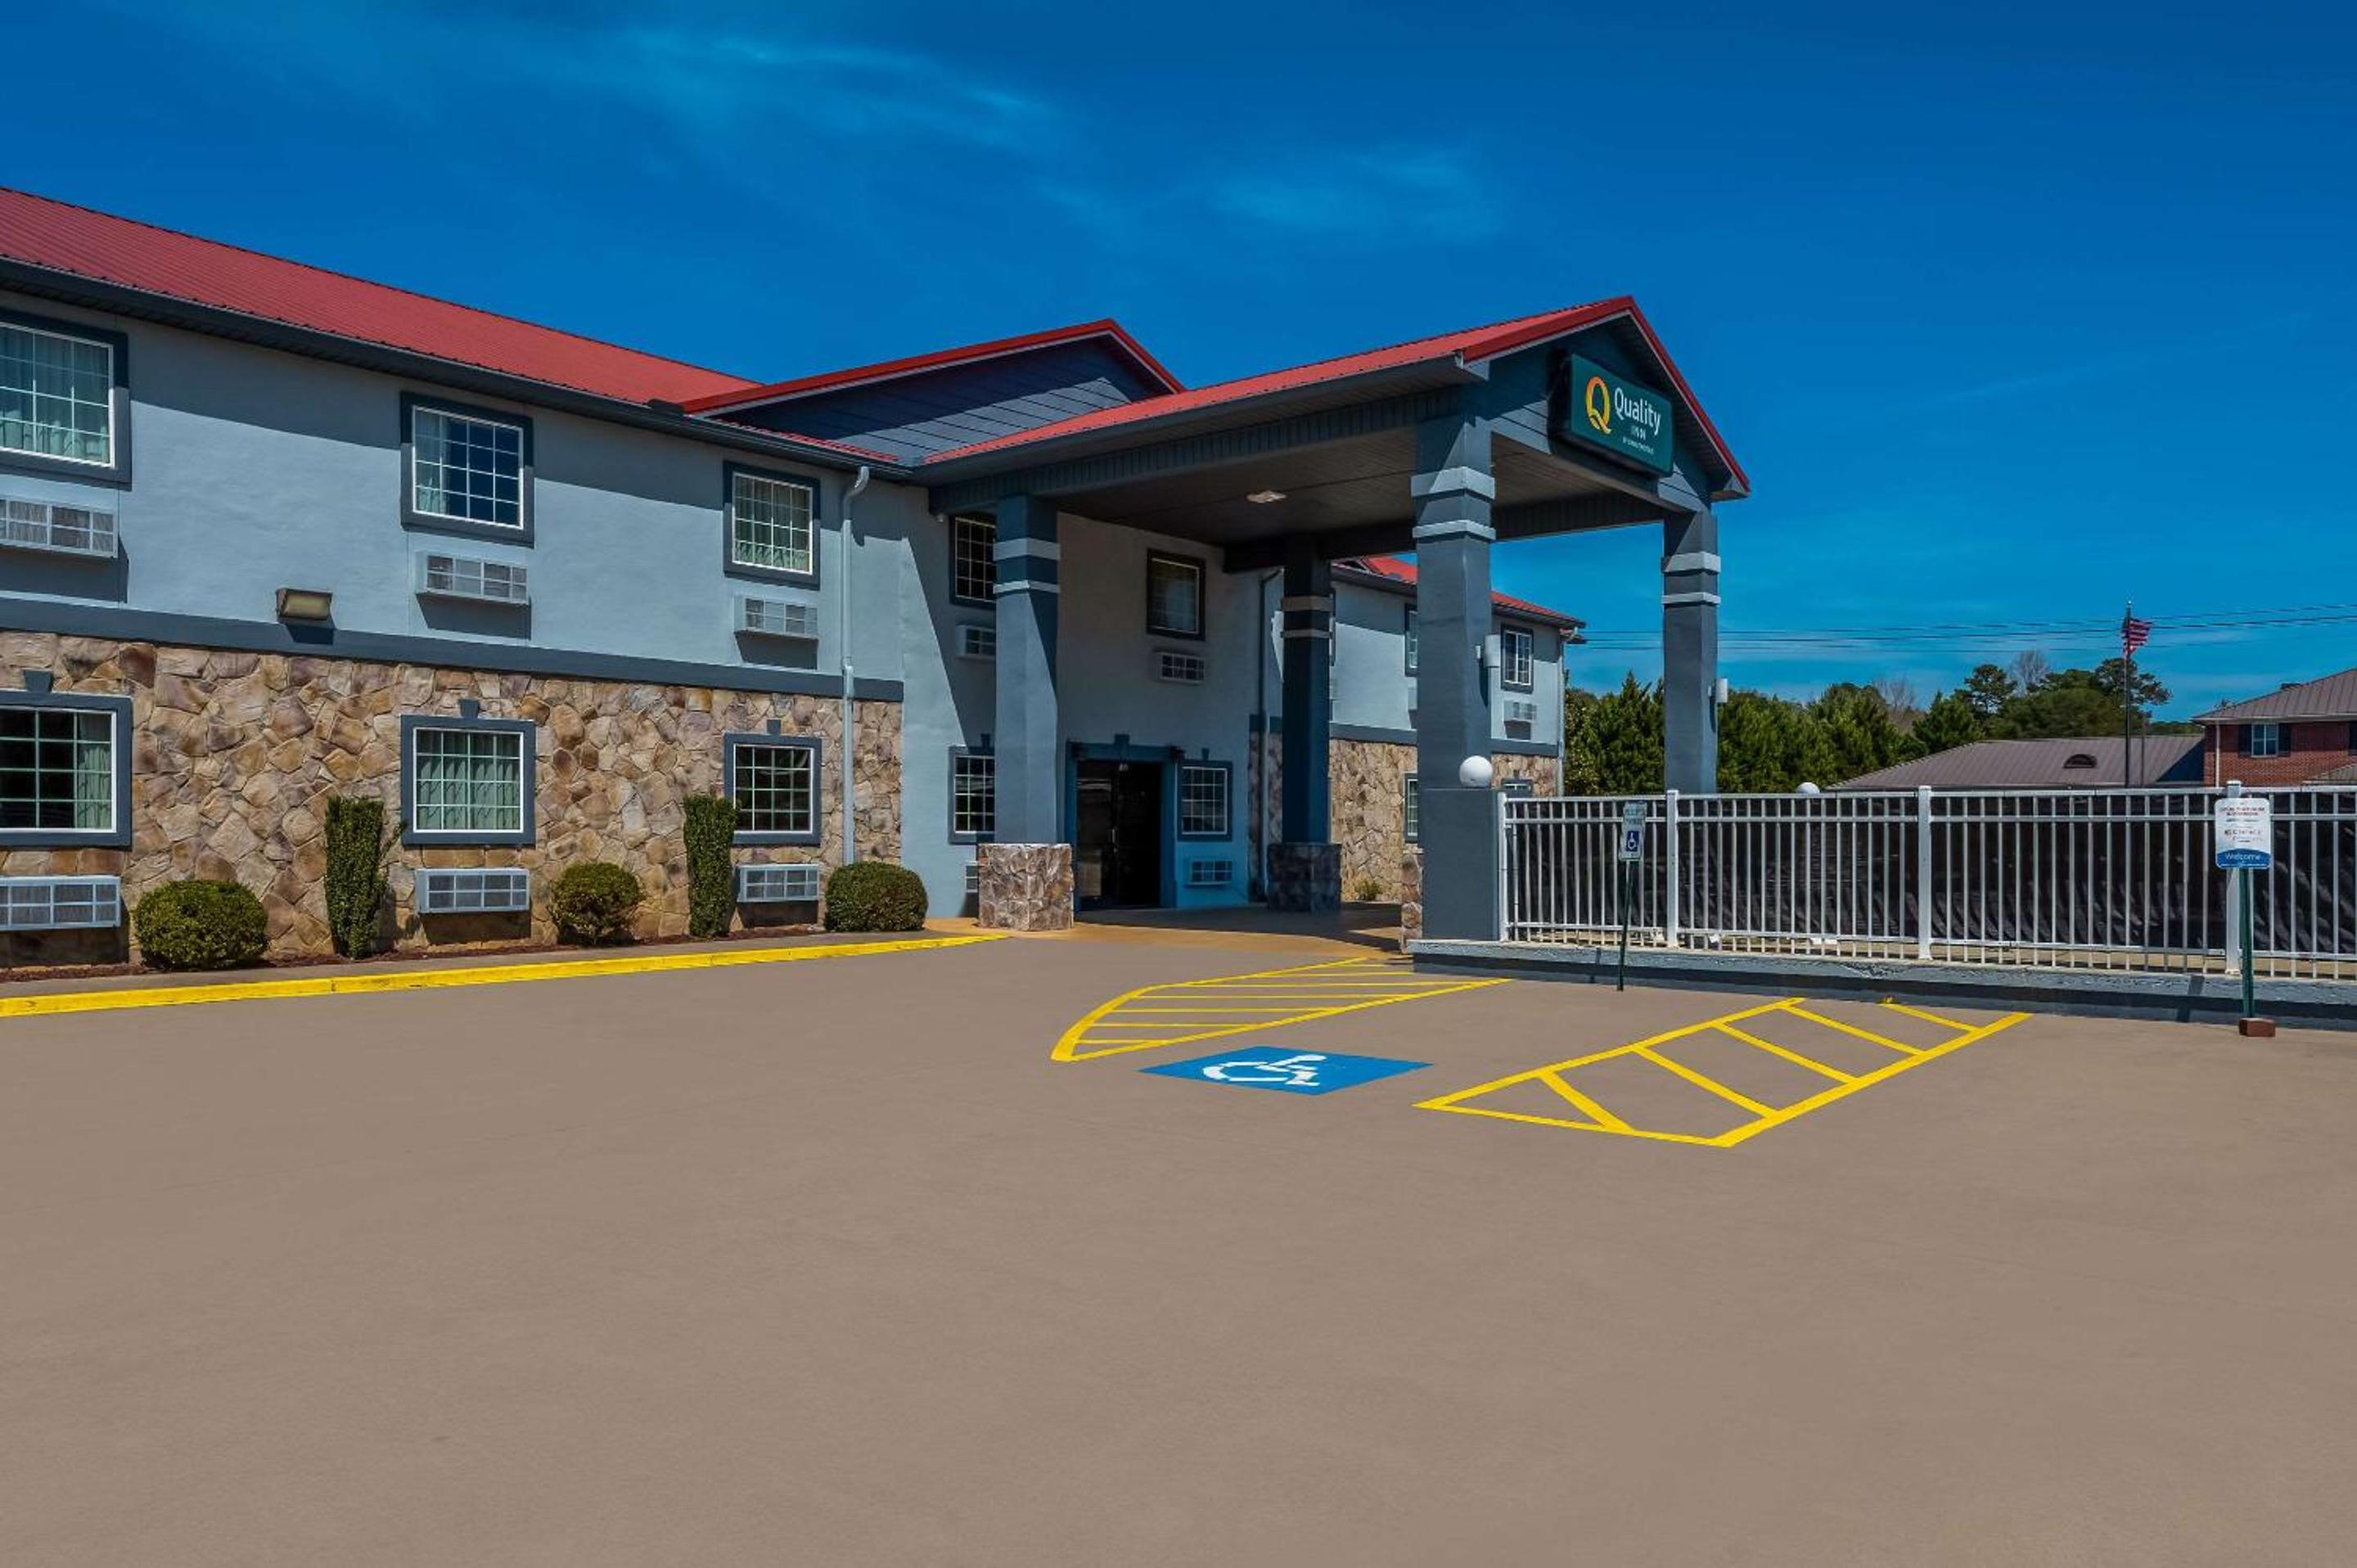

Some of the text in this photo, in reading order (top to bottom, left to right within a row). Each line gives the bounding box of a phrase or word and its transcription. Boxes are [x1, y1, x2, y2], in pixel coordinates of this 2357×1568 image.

[1586, 376, 1611, 434] Q
[1615, 387, 1661, 435] Quality
[2225, 852, 2260, 860] Welcome
